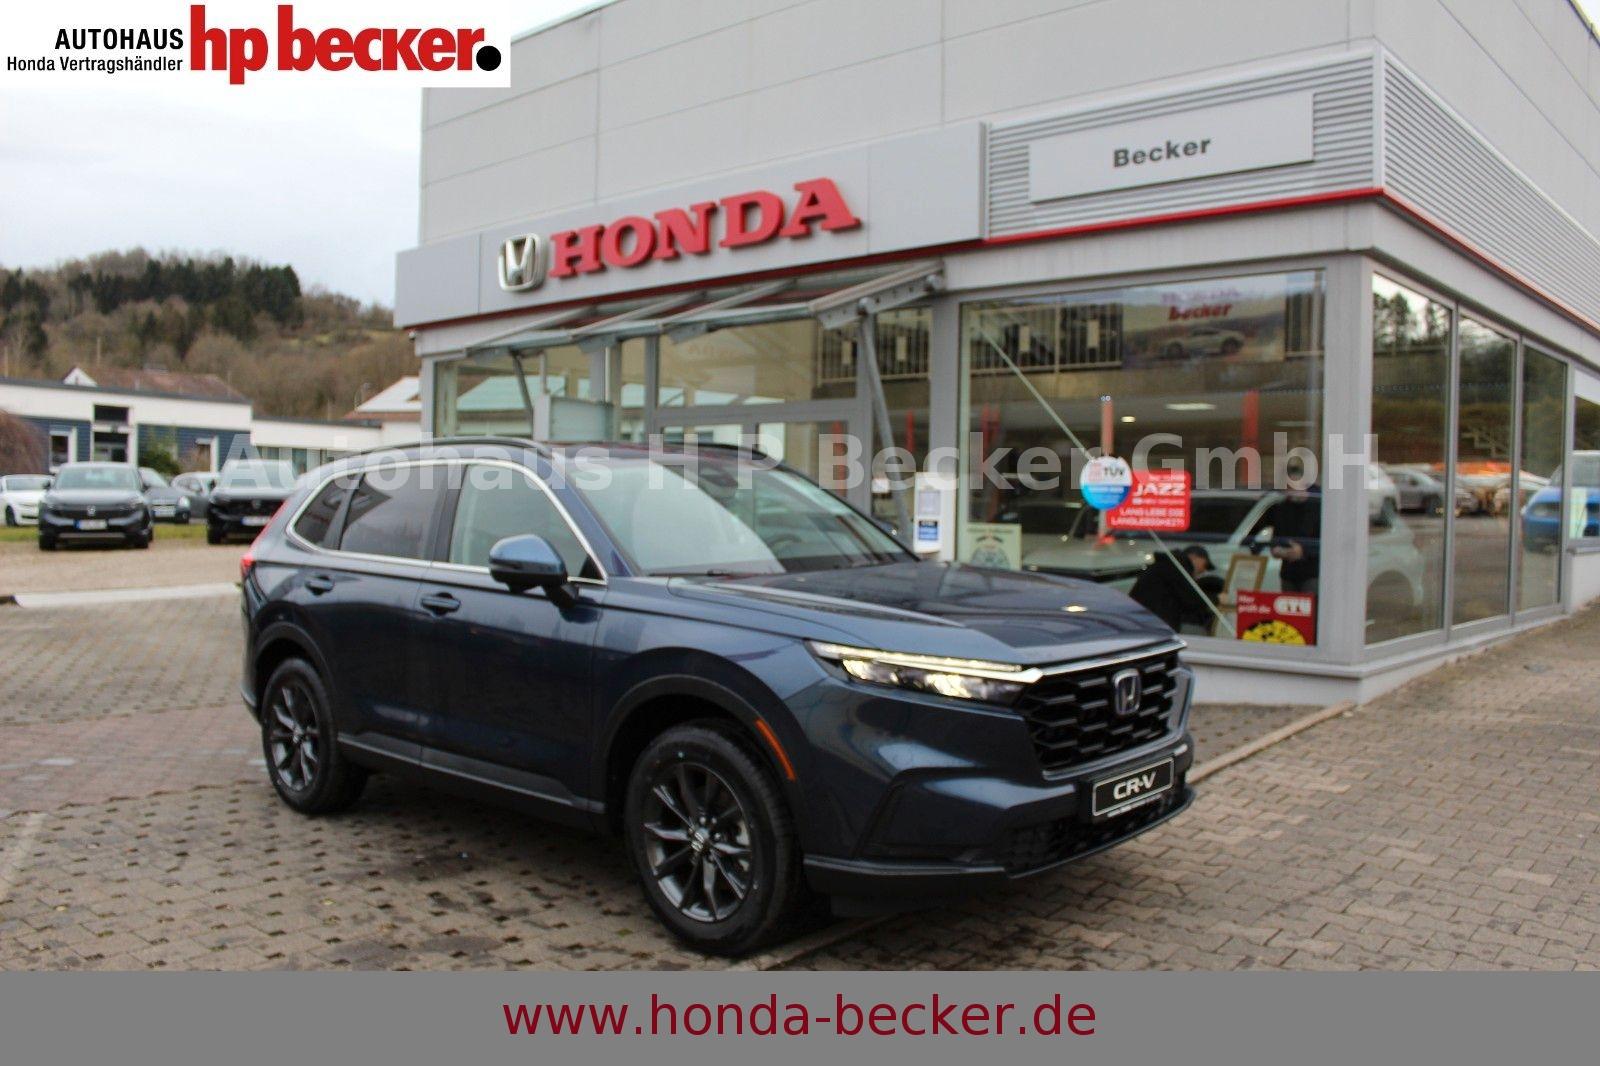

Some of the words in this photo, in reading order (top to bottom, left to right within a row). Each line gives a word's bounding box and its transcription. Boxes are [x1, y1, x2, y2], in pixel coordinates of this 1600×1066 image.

[1113, 138, 1212, 168] Becker
[548, 177, 861, 279] HONDA
[1132, 482, 1186, 497] JAZZ
[1113, 771, 1157, 800] CR-V
